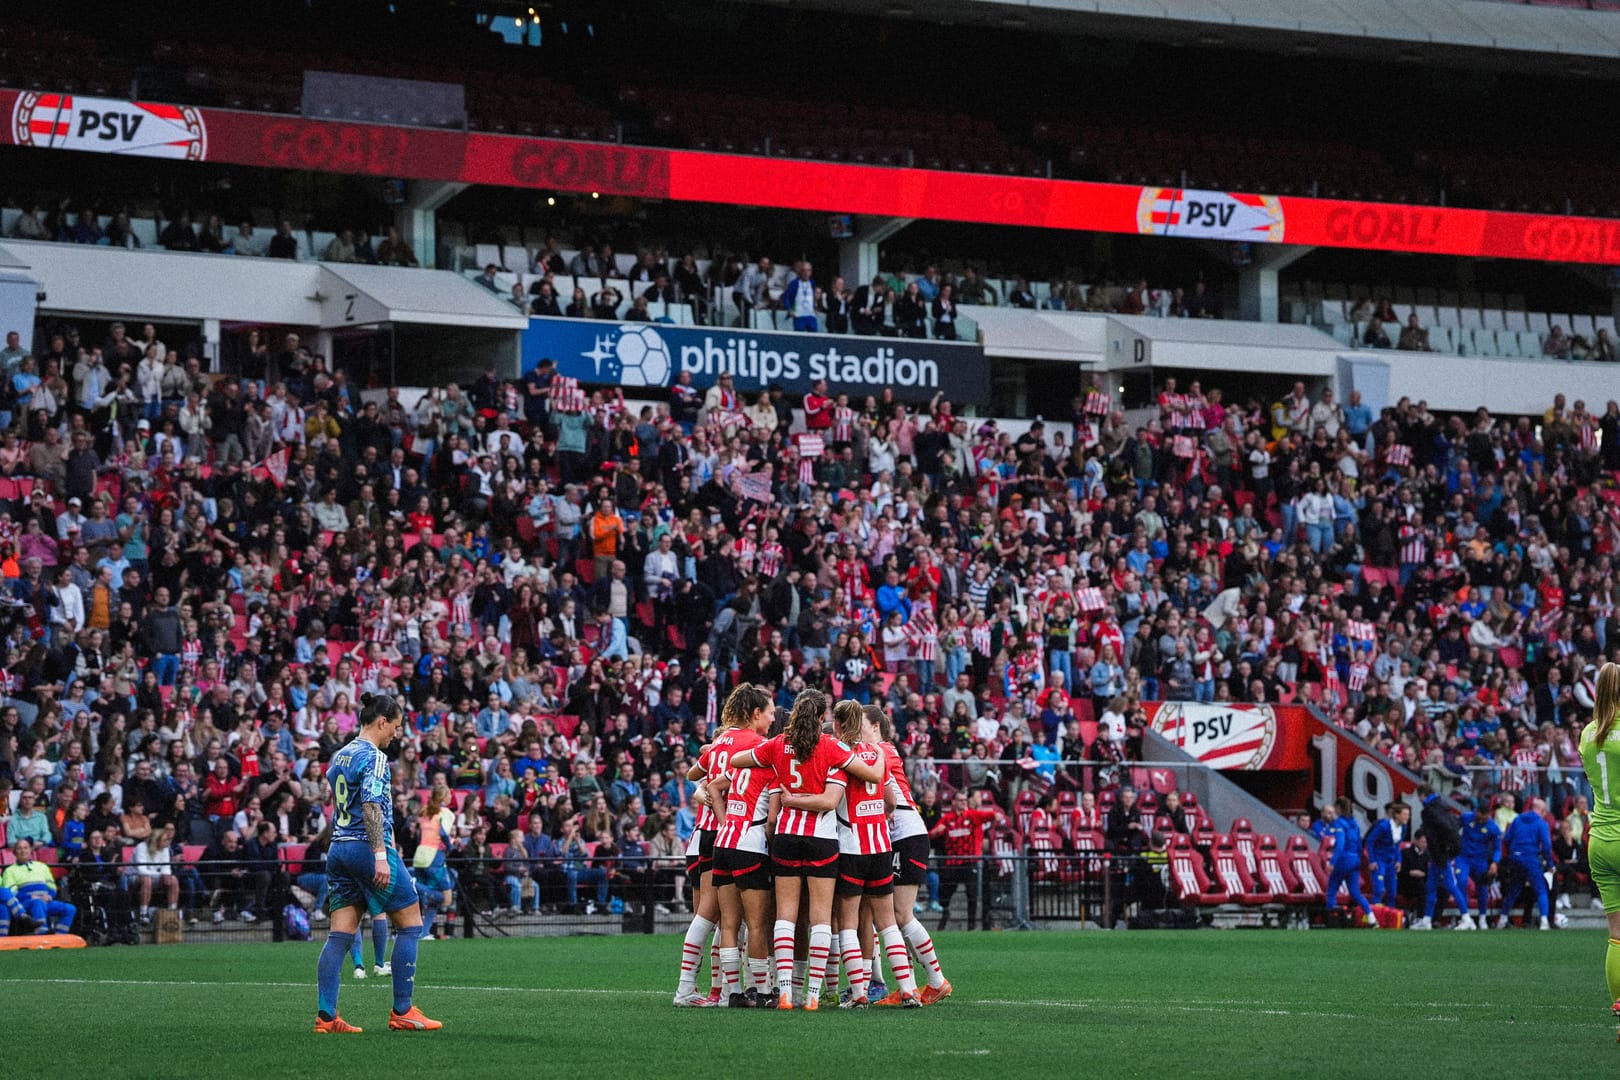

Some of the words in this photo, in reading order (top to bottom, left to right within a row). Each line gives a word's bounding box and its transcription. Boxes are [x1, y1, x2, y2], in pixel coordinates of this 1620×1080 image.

[77, 109, 144, 142] PSV
[1186, 200, 1237, 228] PSV
[1325, 206, 1443, 246] GOAL!
[681, 337, 801, 386] philips
[809, 347, 939, 388] stadion
[1134, 338, 1145, 363] D
[1192, 713, 1233, 744] PSV
[789, 758, 803, 789] 5
[1596, 751, 1611, 805] 1
[335, 774, 352, 828] 8
